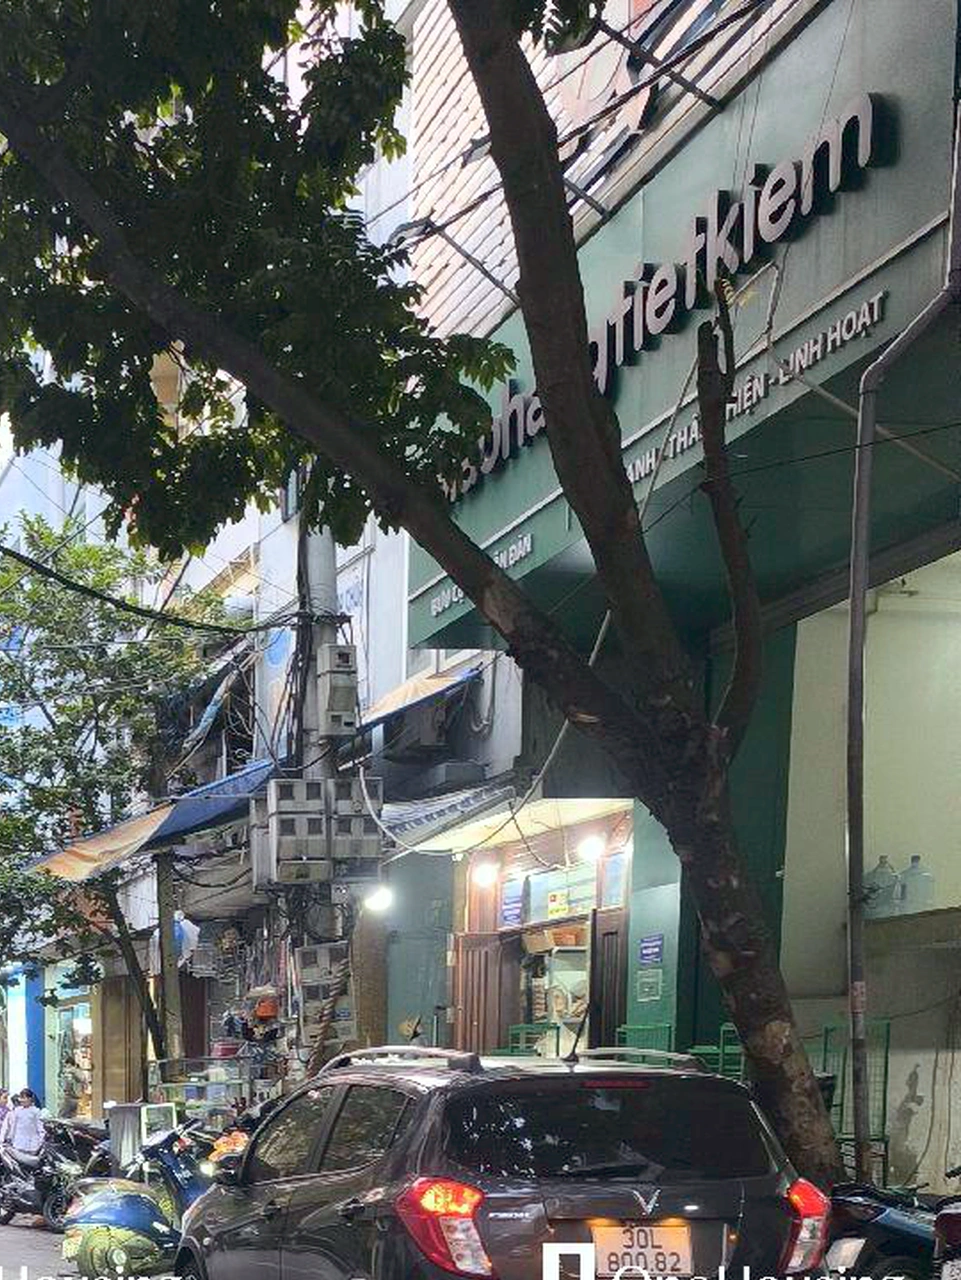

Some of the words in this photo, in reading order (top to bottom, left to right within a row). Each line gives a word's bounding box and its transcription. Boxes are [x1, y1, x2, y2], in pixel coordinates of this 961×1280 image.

[668, 414, 704, 459] THÂ
[725, 372, 765, 421] HIỆN
[779, 332, 823, 386] LINH
[827, 290, 885, 354] HOẠT
[622, 1228, 662, 1249] 30L
